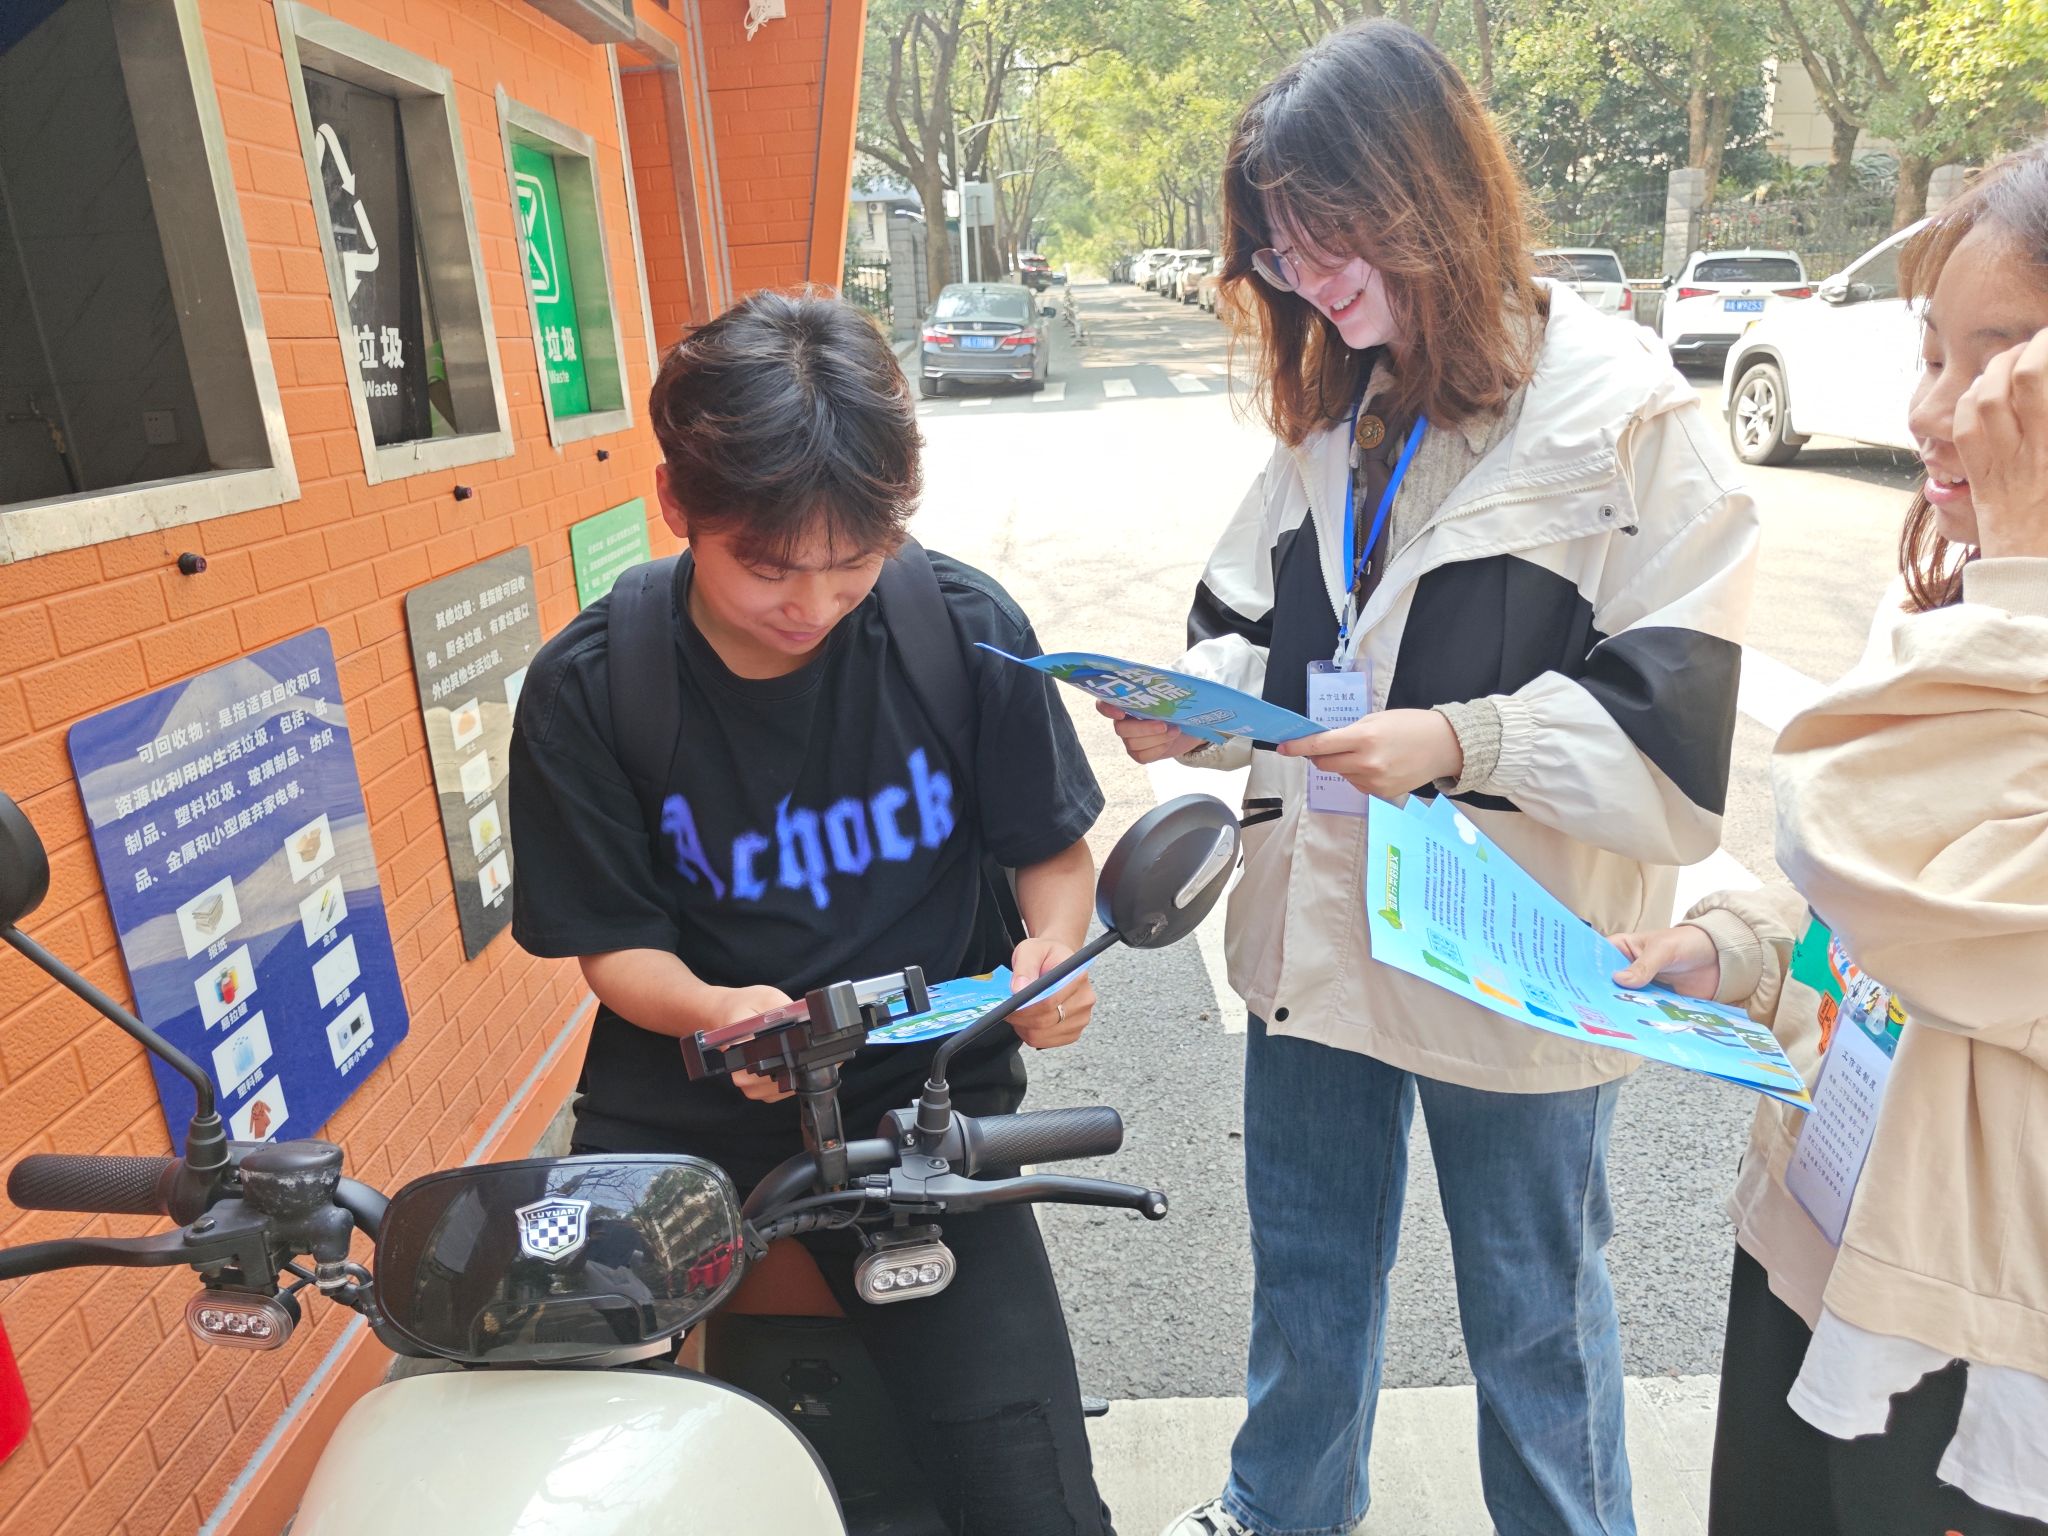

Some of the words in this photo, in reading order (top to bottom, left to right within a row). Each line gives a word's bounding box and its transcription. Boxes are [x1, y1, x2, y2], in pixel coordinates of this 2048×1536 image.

[353, 324, 405, 368] 垃圾
[541, 326, 577, 361] 垃圾
[363, 380, 398, 397] Waste
[548, 370, 570, 384] Waste
[136, 667, 321, 765] 可回收物：是指适宜回收和可
[114, 698, 327, 819] 资源化利用的生活垃圾，包括：纸
[124, 727, 334, 856] 制品、塑料垃圾、玻璃制品、纺织
[134, 780, 305, 893] 品、金属和小型废弃家电等。
[208, 938, 227, 960] 报纸
[531, 1208, 576, 1220] LUYUAN
